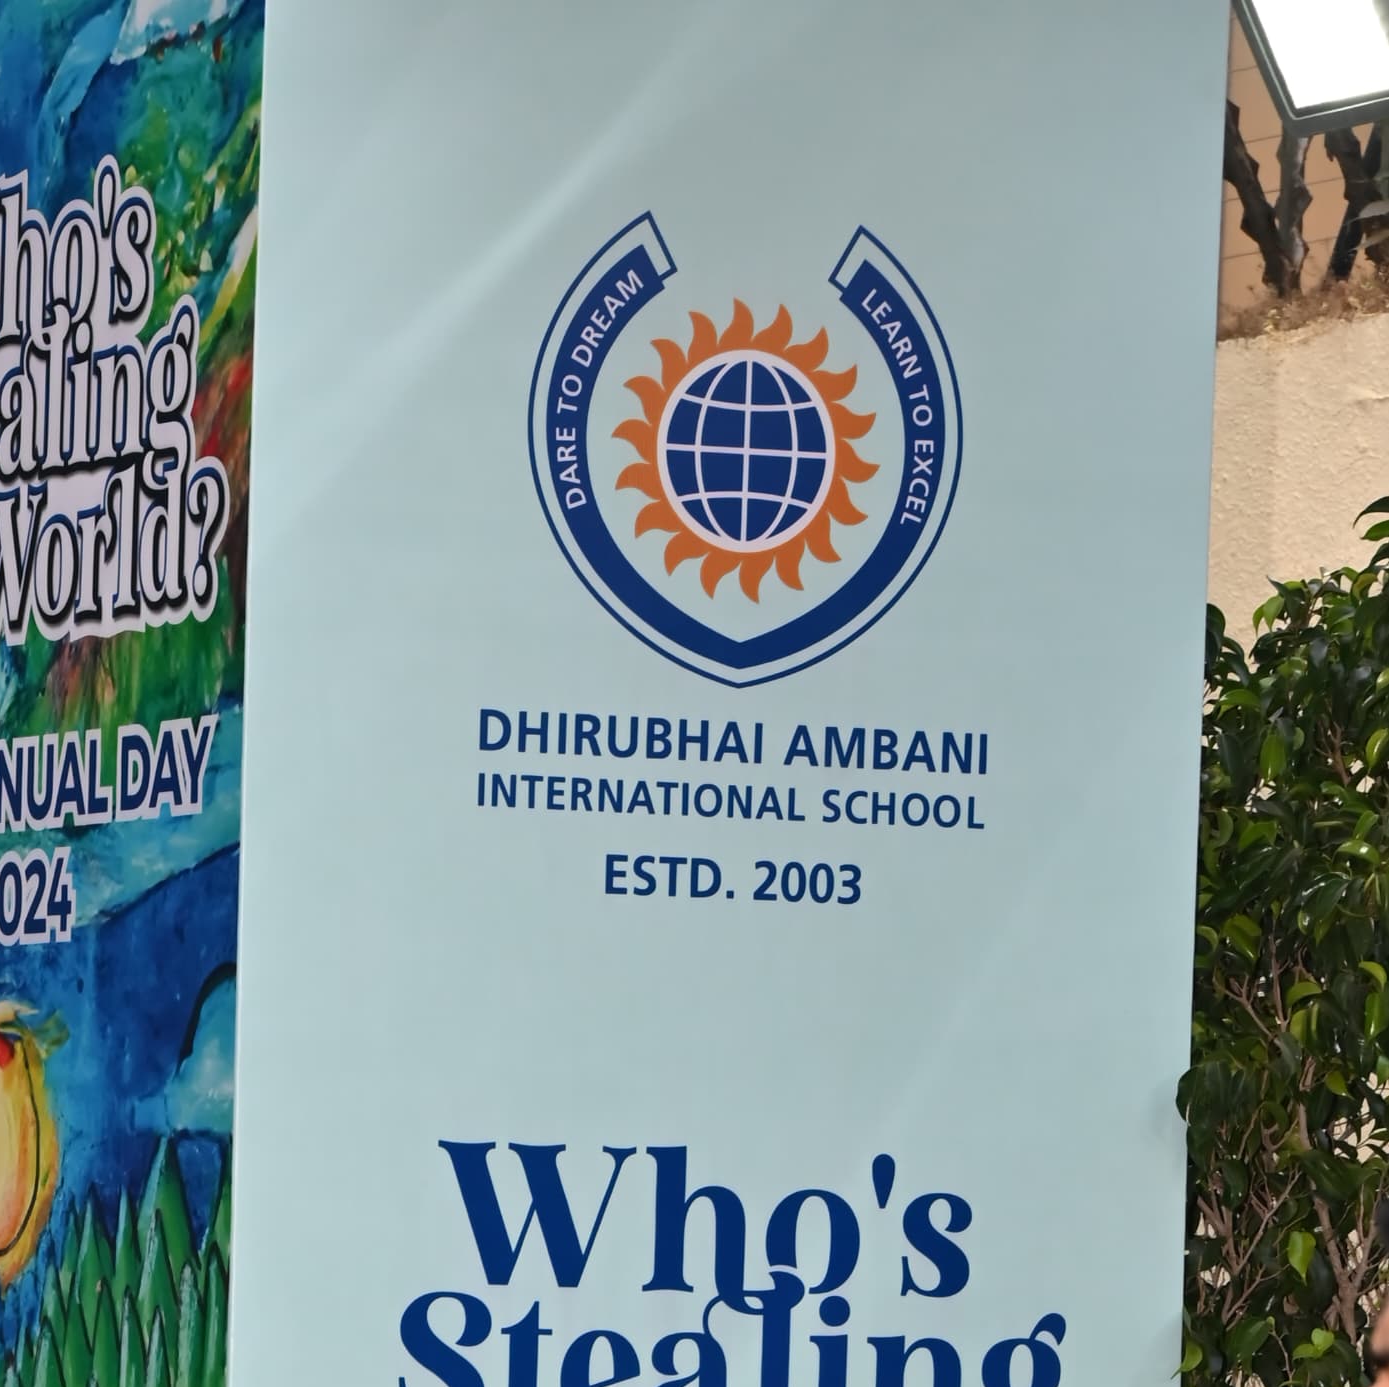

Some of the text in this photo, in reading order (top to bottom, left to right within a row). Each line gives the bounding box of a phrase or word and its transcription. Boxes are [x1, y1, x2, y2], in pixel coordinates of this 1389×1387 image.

[555, 269, 645, 510] DARE TO DREAM
[861, 288, 935, 526] LEARN TO EXCEL
[122, 716, 212, 811] DAY
[477, 708, 989, 775] DHIRUBHAI AMBANI
[476, 772, 986, 830] INTERNATIONAL SCHOOL
[603, 853, 863, 905] ESTD. 2003
[438, 1139, 973, 1316] Who's
